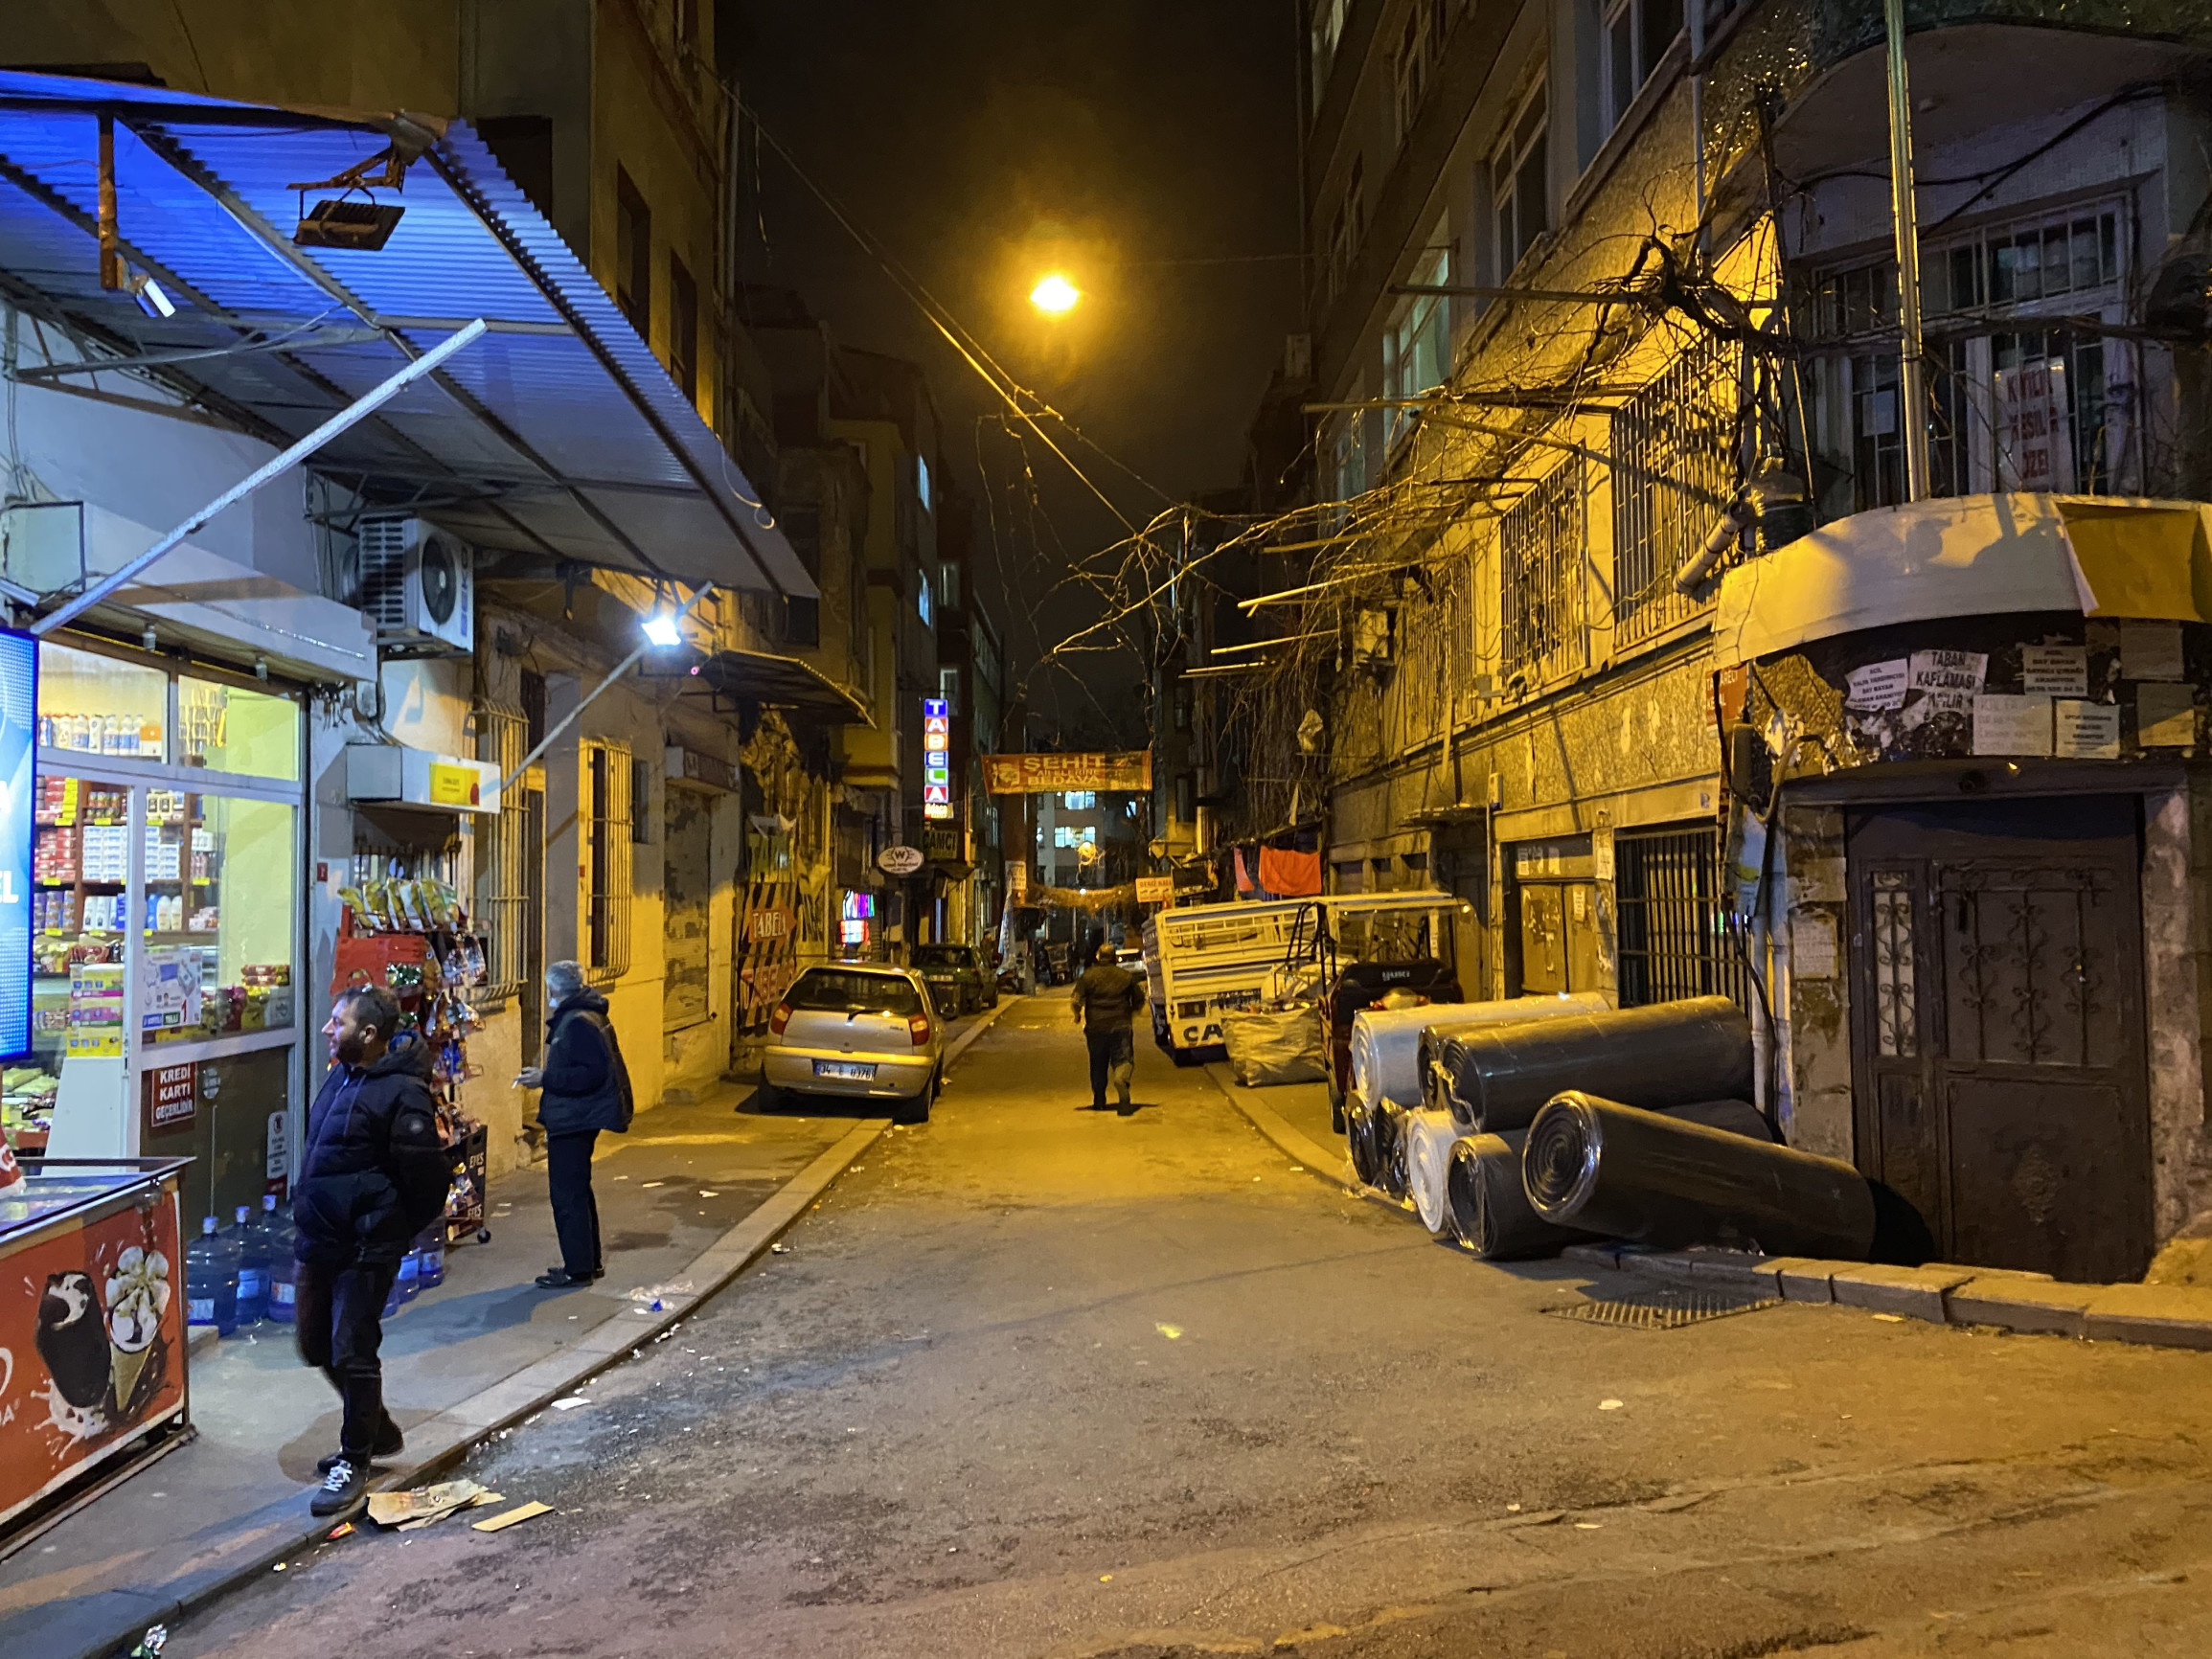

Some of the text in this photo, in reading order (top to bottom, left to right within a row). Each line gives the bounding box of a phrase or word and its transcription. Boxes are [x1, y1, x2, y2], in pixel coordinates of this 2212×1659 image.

[926, 700, 947, 802] TABELA
[1024, 754, 1106, 772] ŞEHİT
[160, 1067, 191, 1084] KREDİ
[160, 1086, 191, 1102] KARTI
[155, 1100, 194, 1120] GEÇERLİDİR
